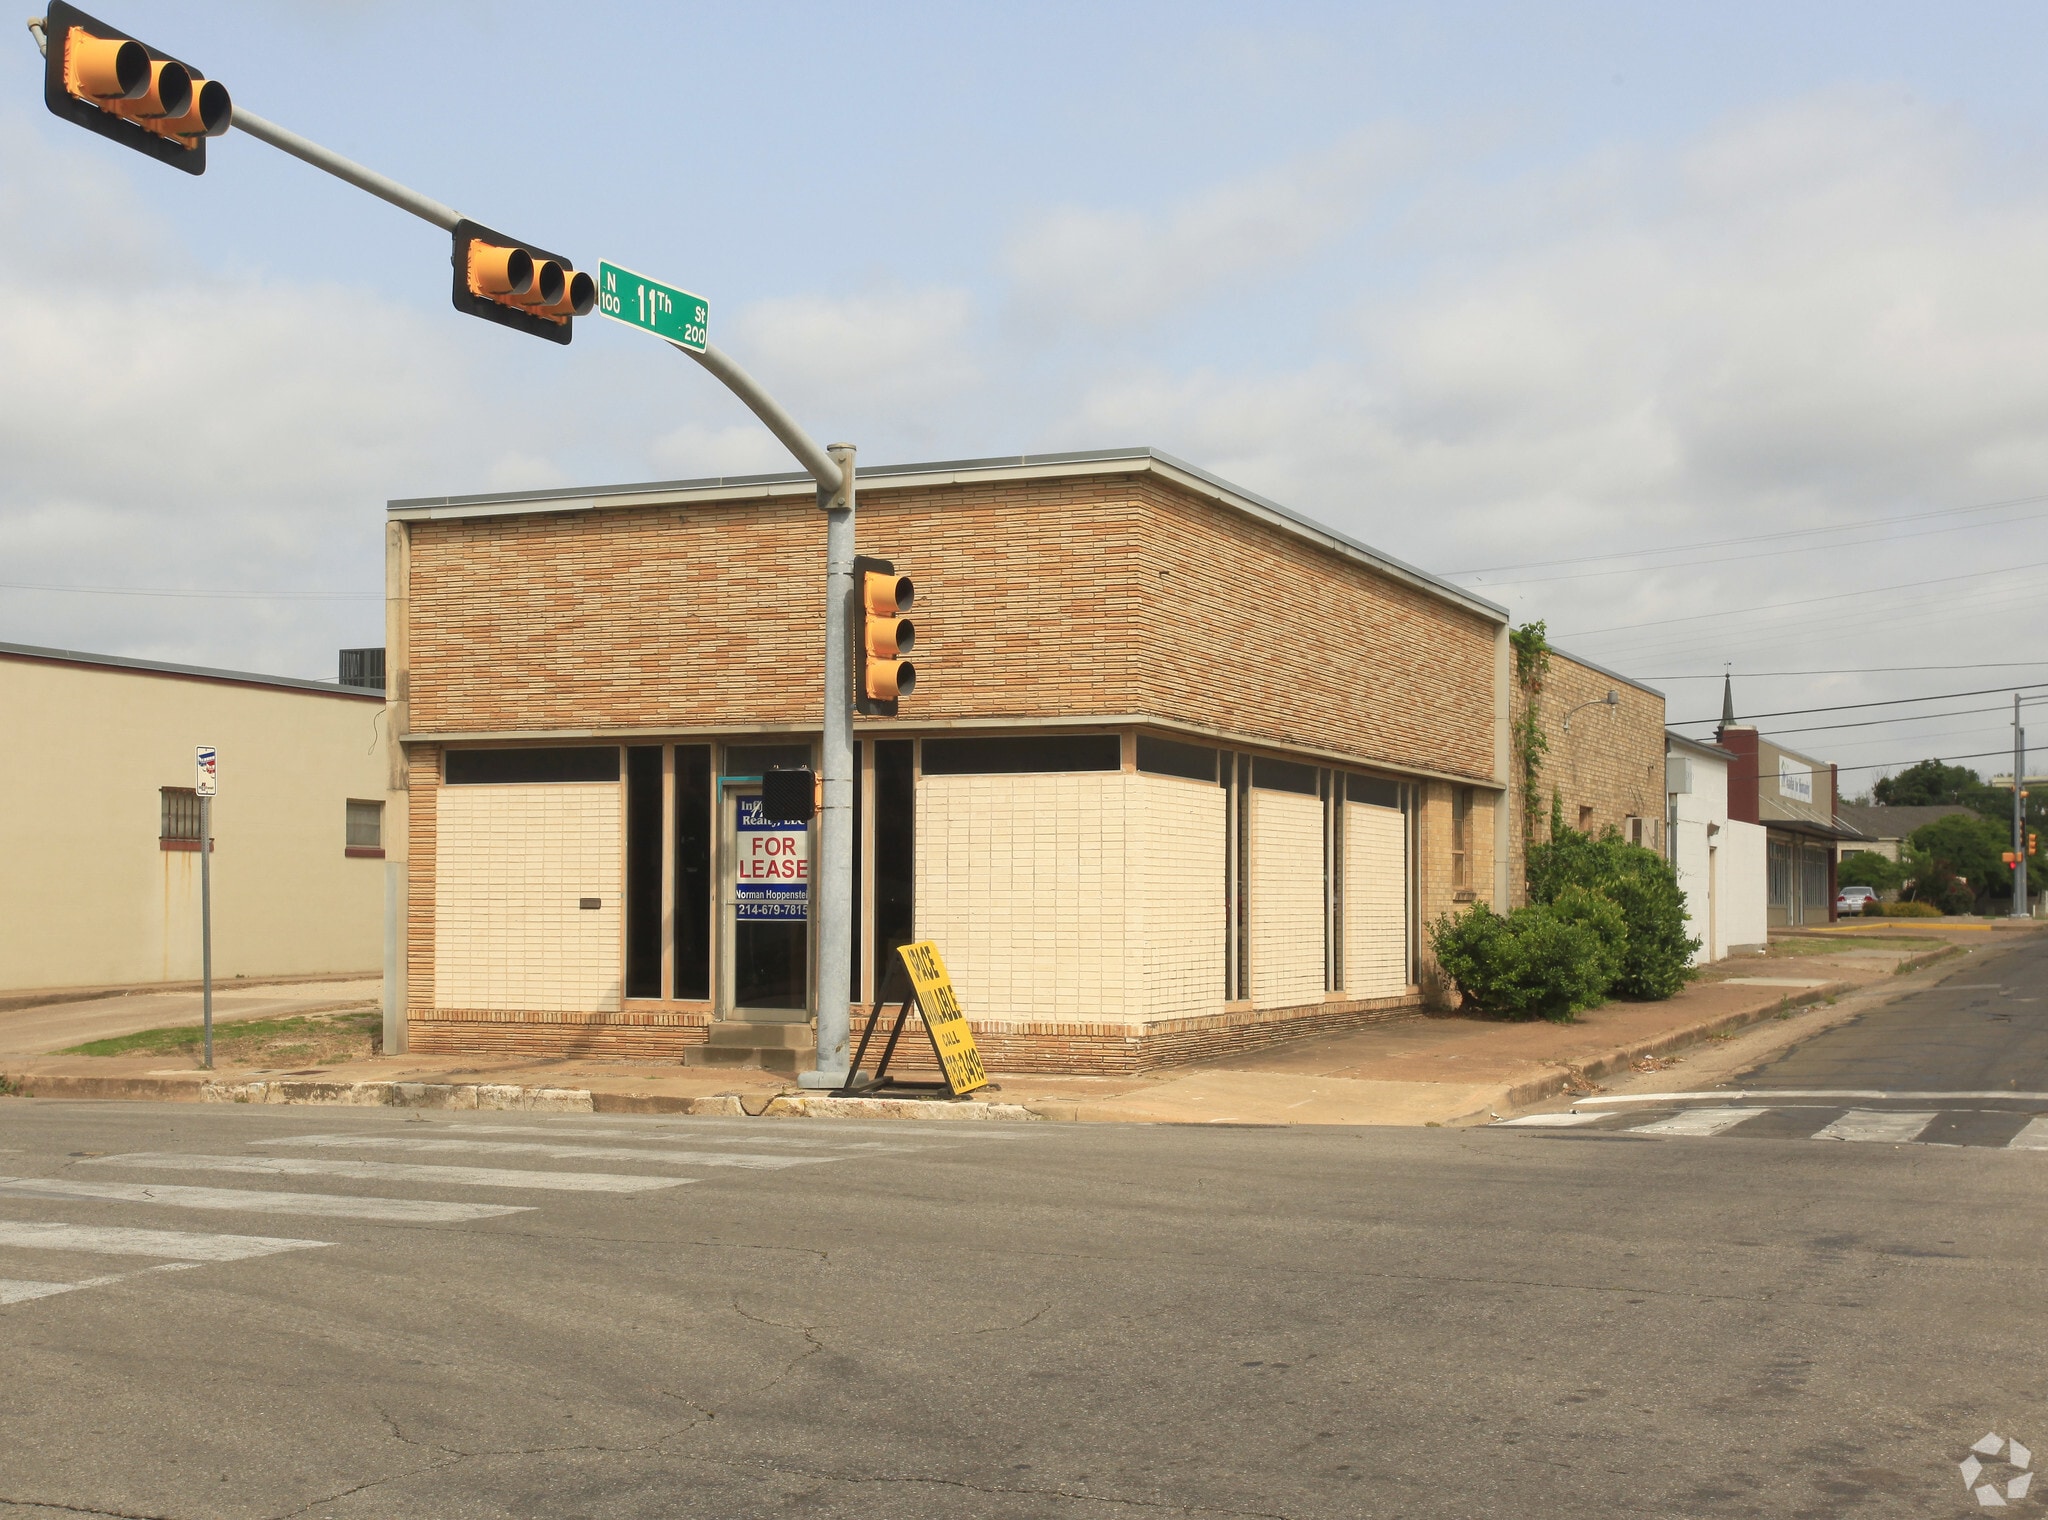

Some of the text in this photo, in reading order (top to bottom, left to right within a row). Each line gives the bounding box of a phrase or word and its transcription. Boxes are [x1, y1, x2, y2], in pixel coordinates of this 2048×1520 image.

[607, 271, 616, 293] N
[601, 292, 621, 314] 100
[694, 306, 706, 324] St
[684, 323, 706, 345] 200
[752, 837, 796, 856] FOR
[739, 859, 808, 879] LEASE
[736, 889, 765, 899] Norman
[738, 904, 808, 915] 214-679-7815
[941, 1030, 961, 1048] CALL
